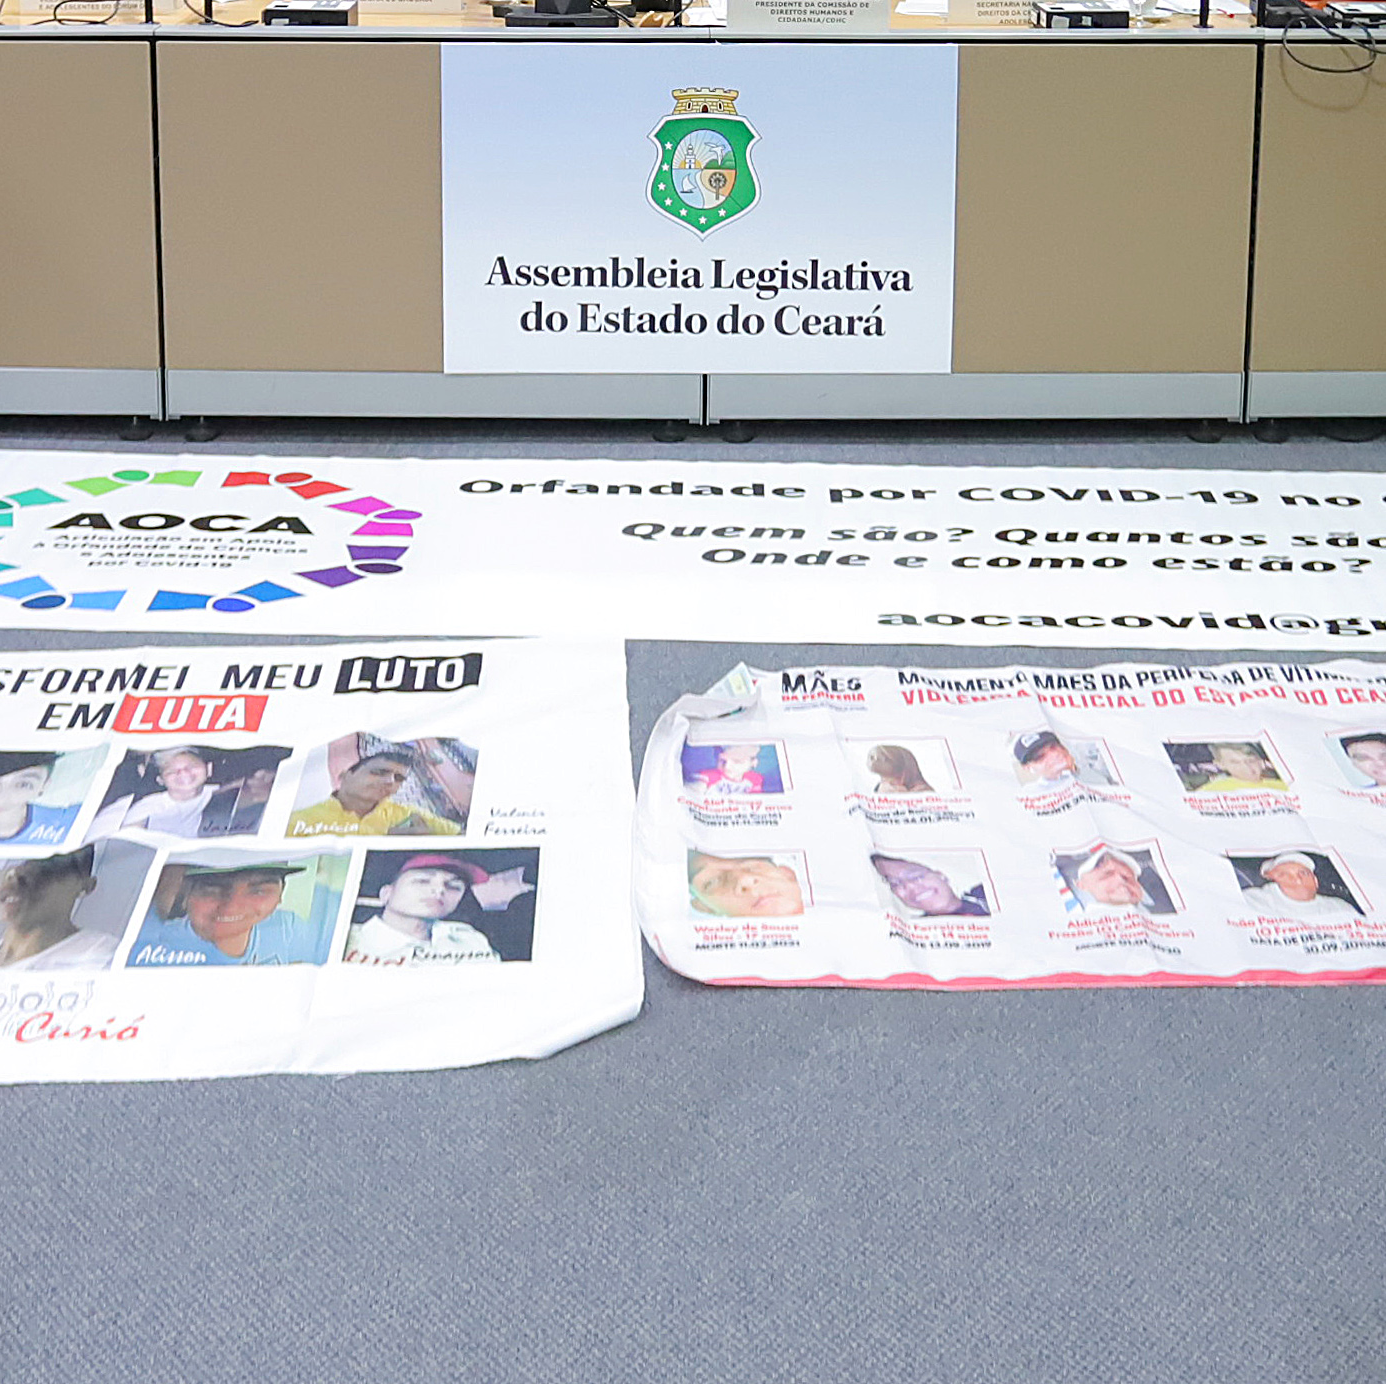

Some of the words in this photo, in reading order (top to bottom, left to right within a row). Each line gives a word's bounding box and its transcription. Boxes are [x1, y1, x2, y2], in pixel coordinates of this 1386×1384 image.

[485, 256, 703, 289] Assembleia
[710, 258, 913, 299] Legislativa
[520, 301, 568, 334] do
[576, 303, 707, 336] Estado
[716, 303, 766, 336] do
[774, 304, 886, 337] Ceará
[459, 479, 807, 498] Orfandade
[829, 486, 937, 503] por
[958, 486, 1259, 507] COVID-19
[1280, 492, 1363, 508] no
[46, 512, 314, 535] AOCA
[622, 522, 807, 540] Quem
[827, 526, 975, 543] são?
[994, 527, 1268, 548] Quantos
[53, 542, 171, 550] Orfandade
[213, 545, 308, 554] Crianças
[55, 534, 183, 543] Articulação
[230, 537, 297, 546] Apoio
[87, 559, 126, 568] por
[135, 560, 232, 569] Covid-19
[100, 552, 252, 560] Adolescentes
[701, 548, 871, 566] Onde
[893, 556, 929, 568] e
[951, 554, 1127, 572] como
[1151, 555, 1373, 575] estão?
[220, 663, 322, 691] MEU
[347, 656, 467, 693] LUTO
[782, 670, 862, 694] MÃES
[898, 671, 1028, 693] MOVIMENTO
[1102, 672, 1131, 691] DA
[1251, 666, 1277, 683] DE
[1037, 690, 1145, 709] POLICIAL
[1153, 688, 1186, 707] DO
[1195, 685, 1287, 707] ESTADO
[1293, 689, 1328, 706] DO
[37, 701, 114, 732] EM
[129, 696, 248, 732] LUTA
[484, 821, 548, 839] Ferreira
[135, 943, 207, 966] Alisson
[15, 1011, 146, 1044] Curió
